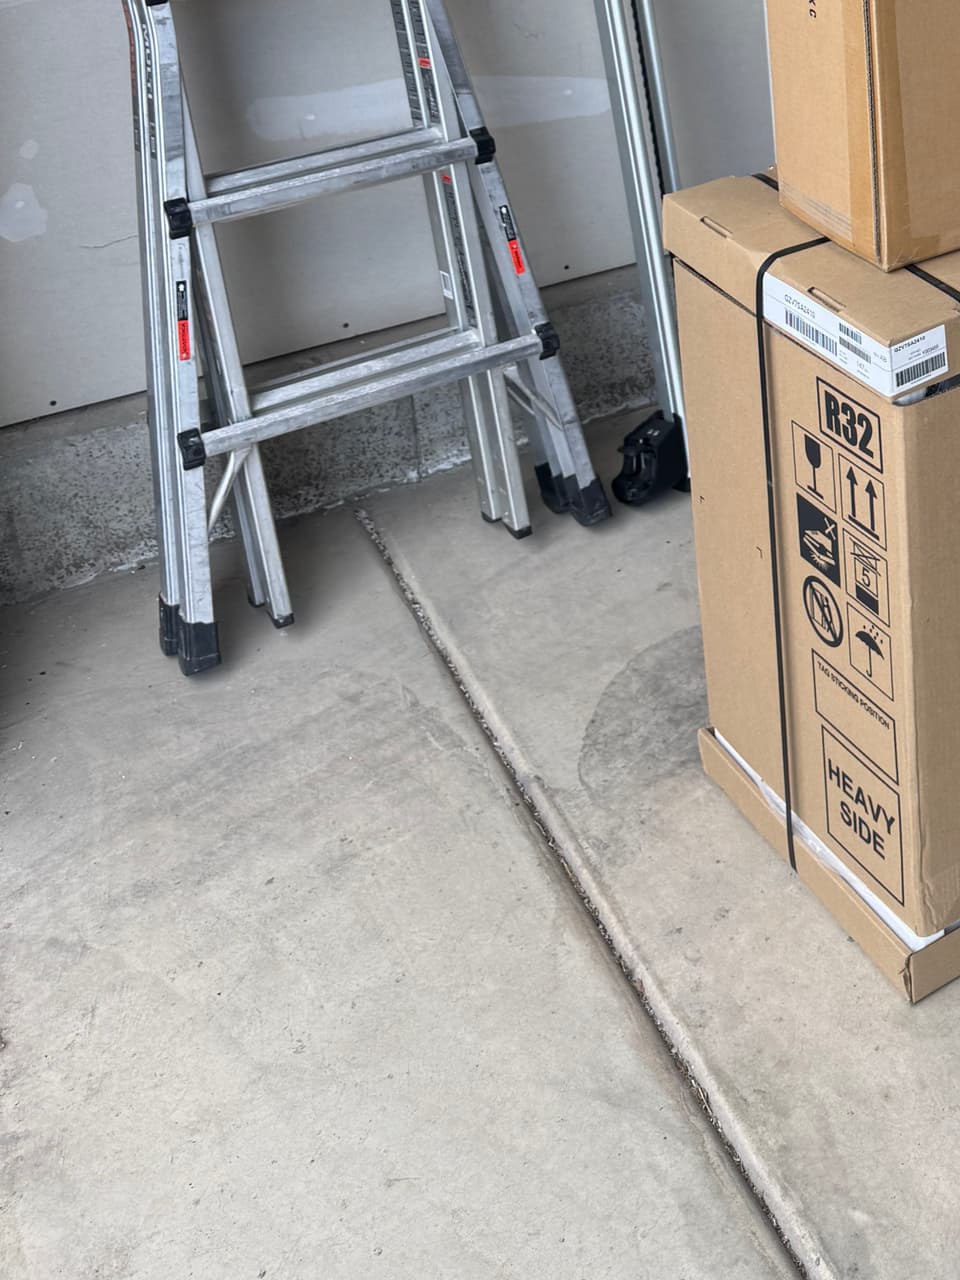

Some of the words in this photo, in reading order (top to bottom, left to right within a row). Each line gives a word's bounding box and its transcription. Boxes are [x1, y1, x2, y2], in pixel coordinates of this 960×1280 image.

[809, 8, 817, 19] C
[824, 389, 874, 460] R32
[861, 569, 872, 588] 5
[817, 660, 831, 678] TAG
[859, 694, 890, 730] POSITION
[827, 757, 896, 835] HEAVY
[839, 800, 886, 861] SIDE
